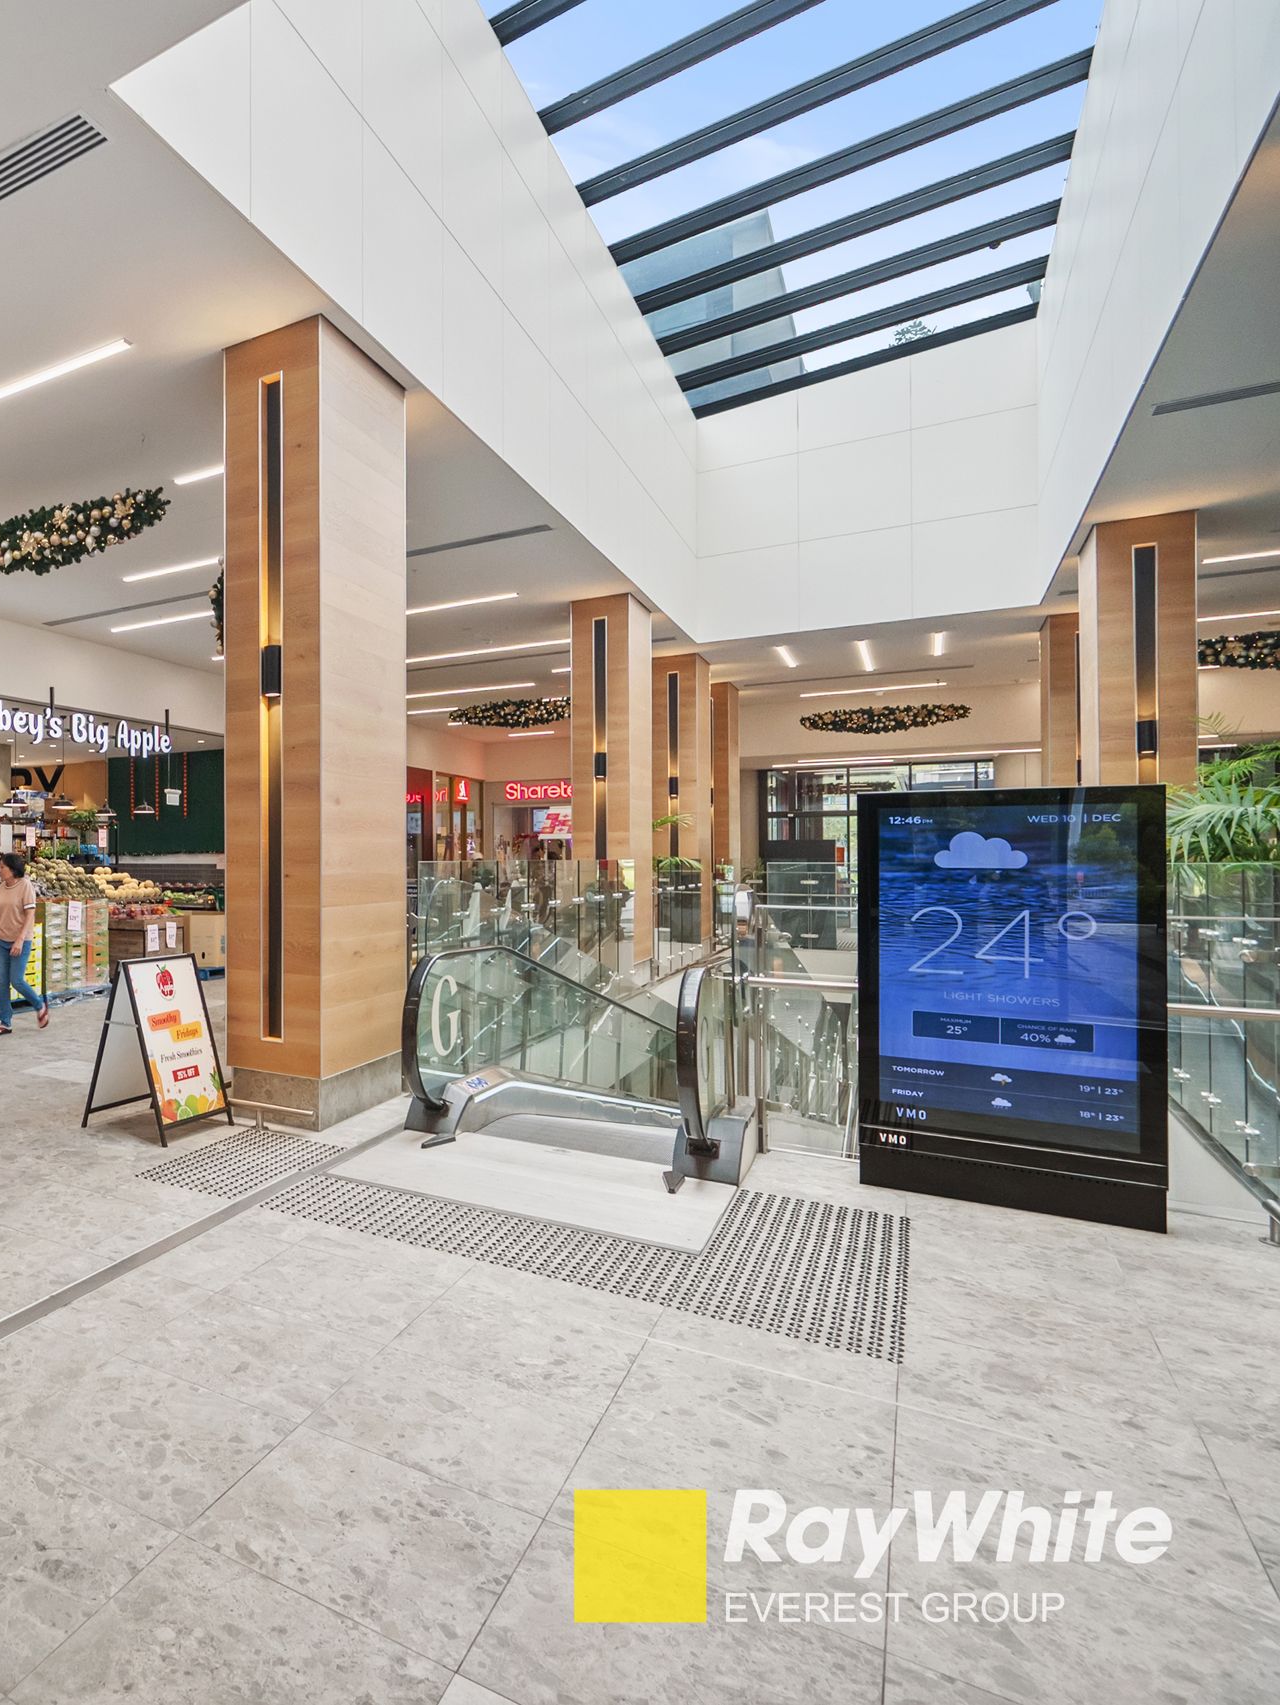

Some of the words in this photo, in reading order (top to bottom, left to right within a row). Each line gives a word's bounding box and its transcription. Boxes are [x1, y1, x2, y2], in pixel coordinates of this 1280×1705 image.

[70, 713, 109, 753] Big
[115, 720, 172, 758] Apple
[1027, 815, 1058, 823] WED
[1063, 814, 1076, 823] 10
[1092, 813, 1122, 822] DEC
[943, 991, 982, 1001] LIGHT
[987, 993, 1061, 1008] SHOWERS
[151, 1014, 177, 1026] Smoothy
[431, 975, 461, 1056] G
[1016, 1023, 1046, 1031] CHANCE
[176, 1028, 199, 1039] Fridays
[1020, 1033, 1051, 1043] 40%
[160, 1052, 177, 1063] Fresh
[177, 1047, 203, 1058] Smoothies
[891, 1065, 945, 1076] TOMORROW
[891, 1088, 924, 1098] FRIDAY
[896, 1106, 927, 1120] VMO
[879, 1132, 907, 1145] VMO
